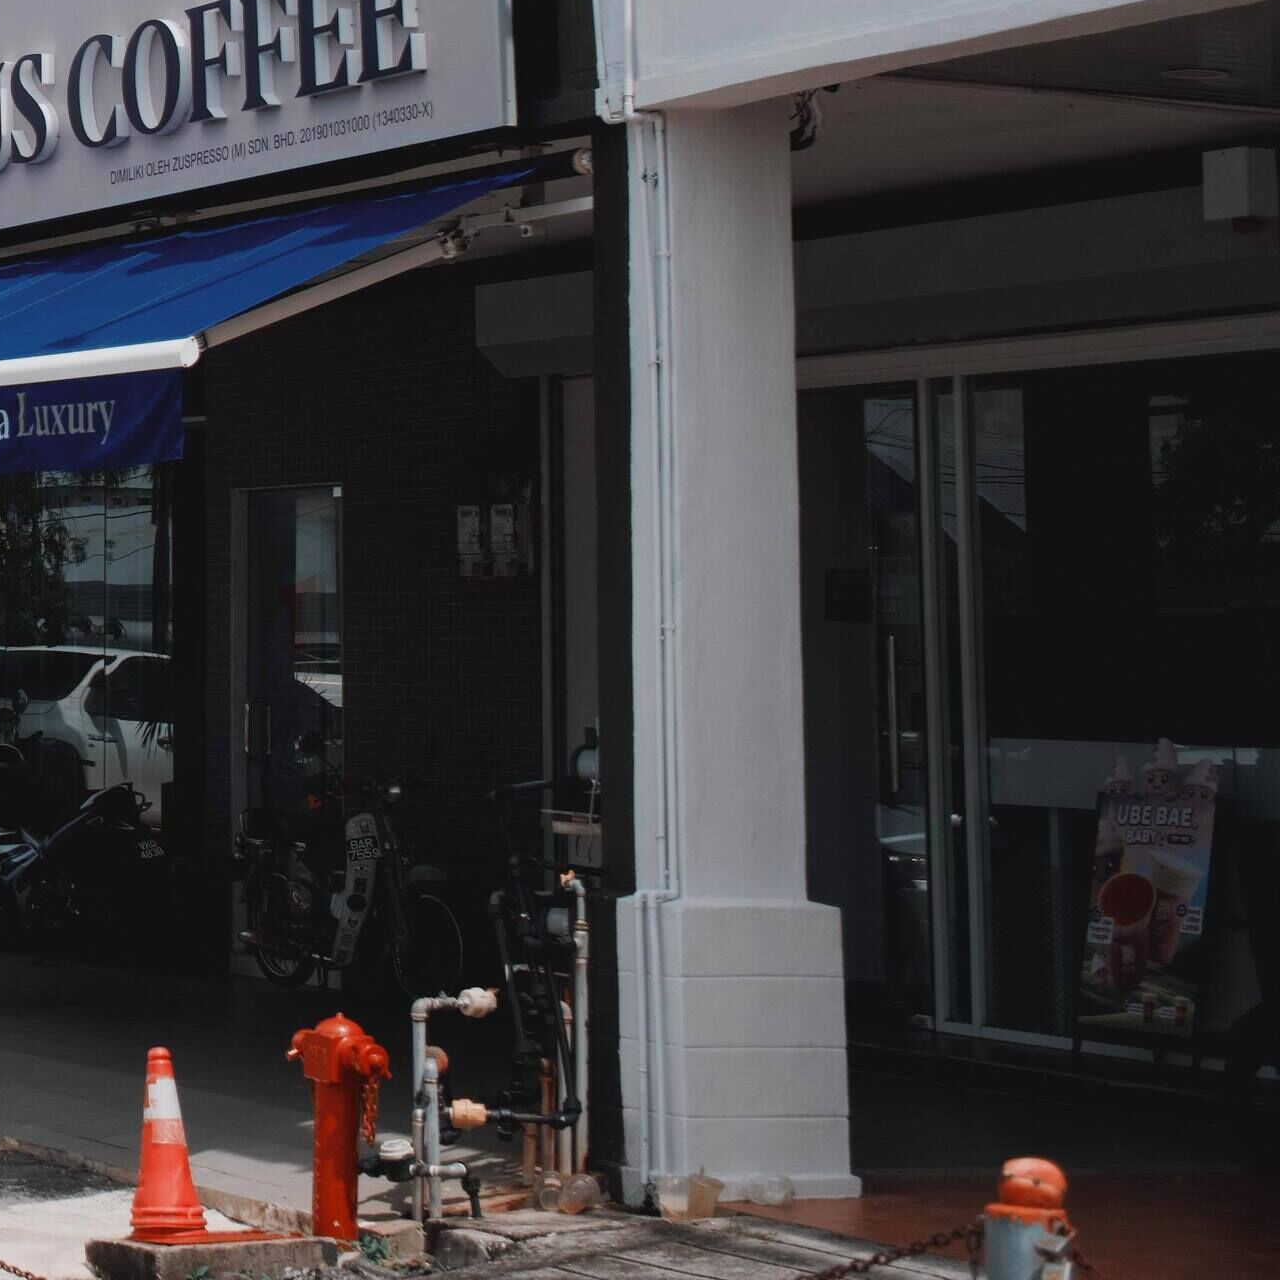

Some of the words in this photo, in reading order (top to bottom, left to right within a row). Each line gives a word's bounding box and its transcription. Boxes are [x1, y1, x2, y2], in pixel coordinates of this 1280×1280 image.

[110, 163, 145, 186] DIMILIKI
[146, 158, 171, 178] OLEH
[170, 146, 229, 172] ZUSPRESSO
[231, 142, 246, 162] (M)
[248, 137, 271, 156] SDN.
[273, 131, 298, 150] BHD.
[299, 117, 370, 145] 201901031000
[372, 99, 433, 133] (1340330-X)
[15, 391, 116, 445] Luxury
[1117, 803, 1153, 826] UBE
[349, 837, 375, 850] BAR
